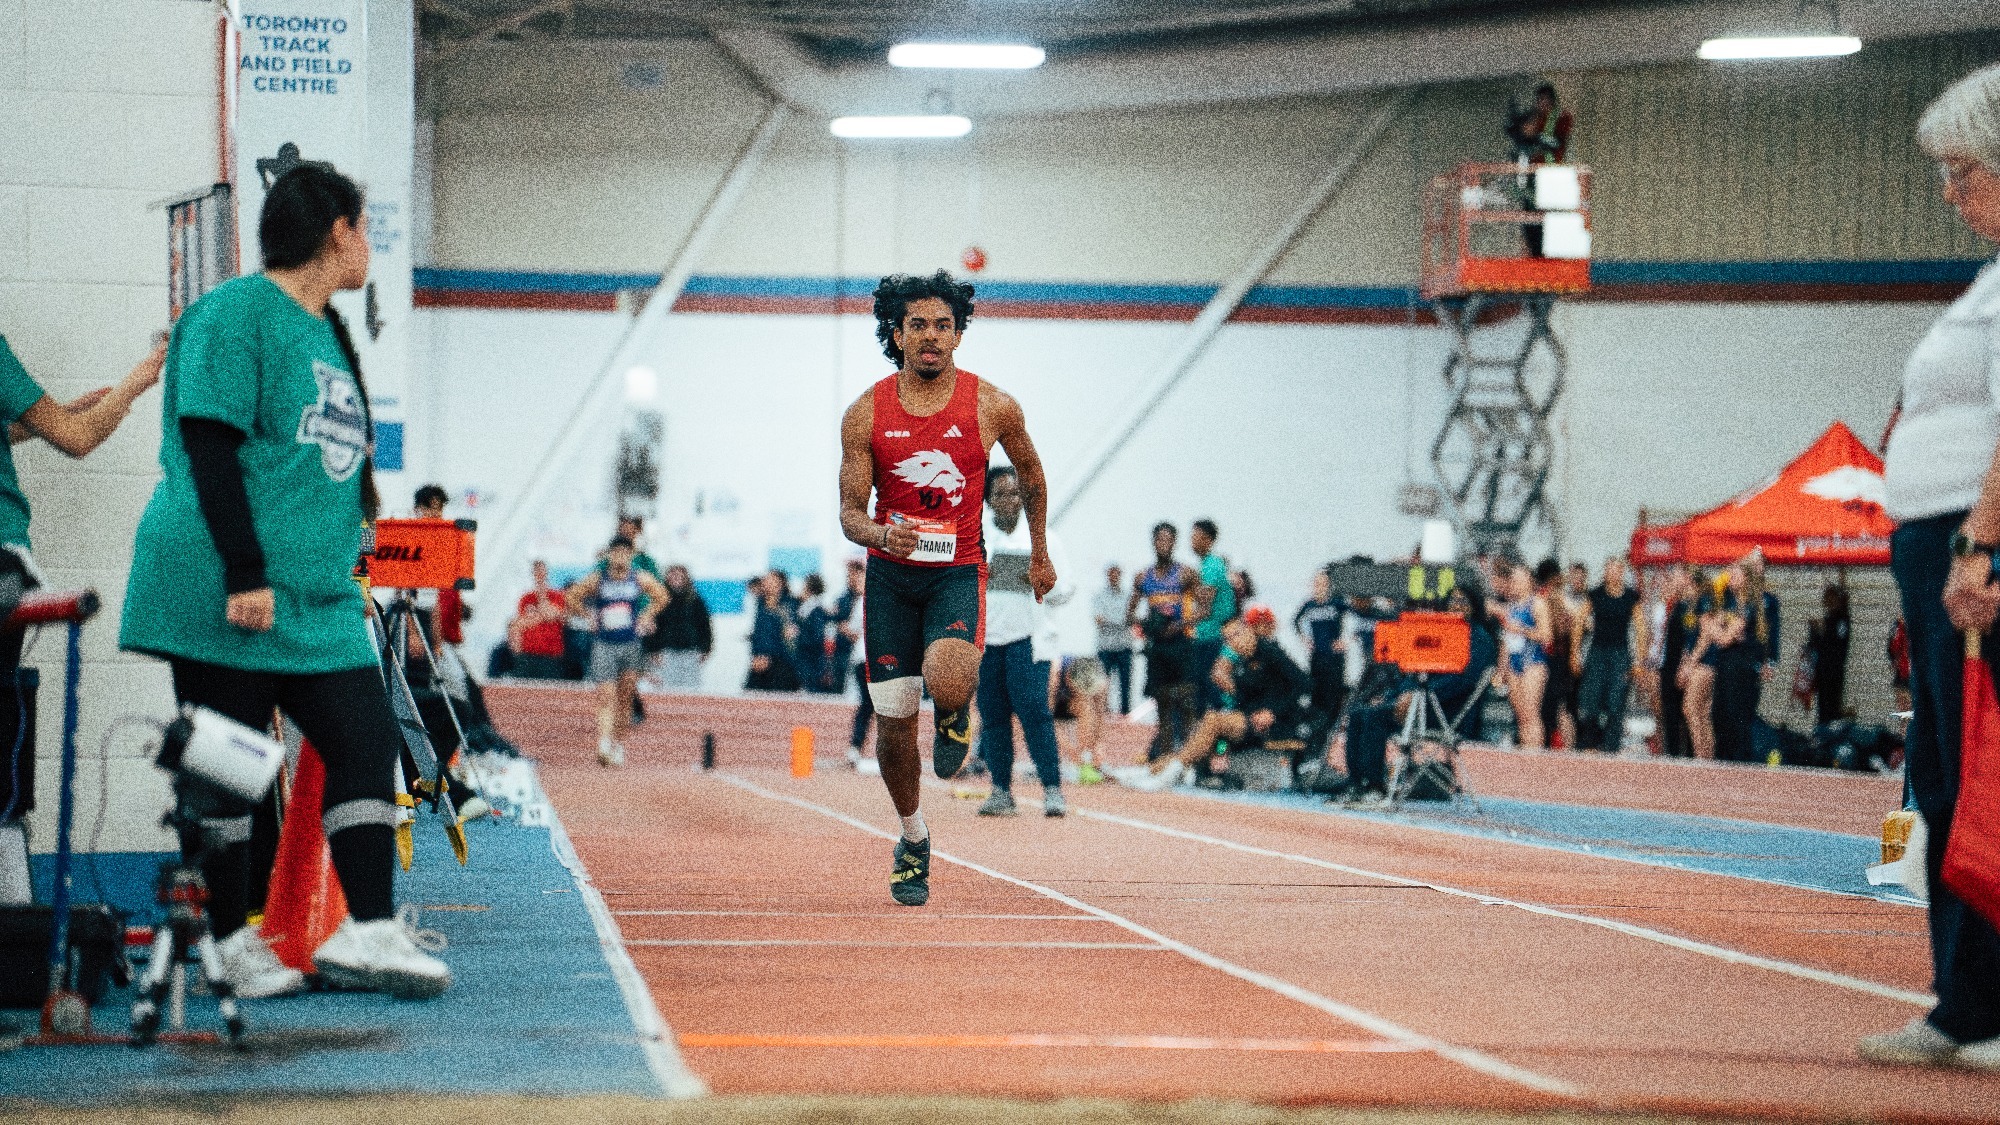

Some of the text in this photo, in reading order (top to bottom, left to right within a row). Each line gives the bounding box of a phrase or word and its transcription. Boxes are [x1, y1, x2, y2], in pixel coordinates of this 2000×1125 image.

[243, 14, 348, 34] TORONTO
[259, 35, 331, 53] TRACK
[241, 55, 352, 74] AND FIELD
[254, 76, 338, 95] CENTRE
[919, 490, 942, 510] YU
